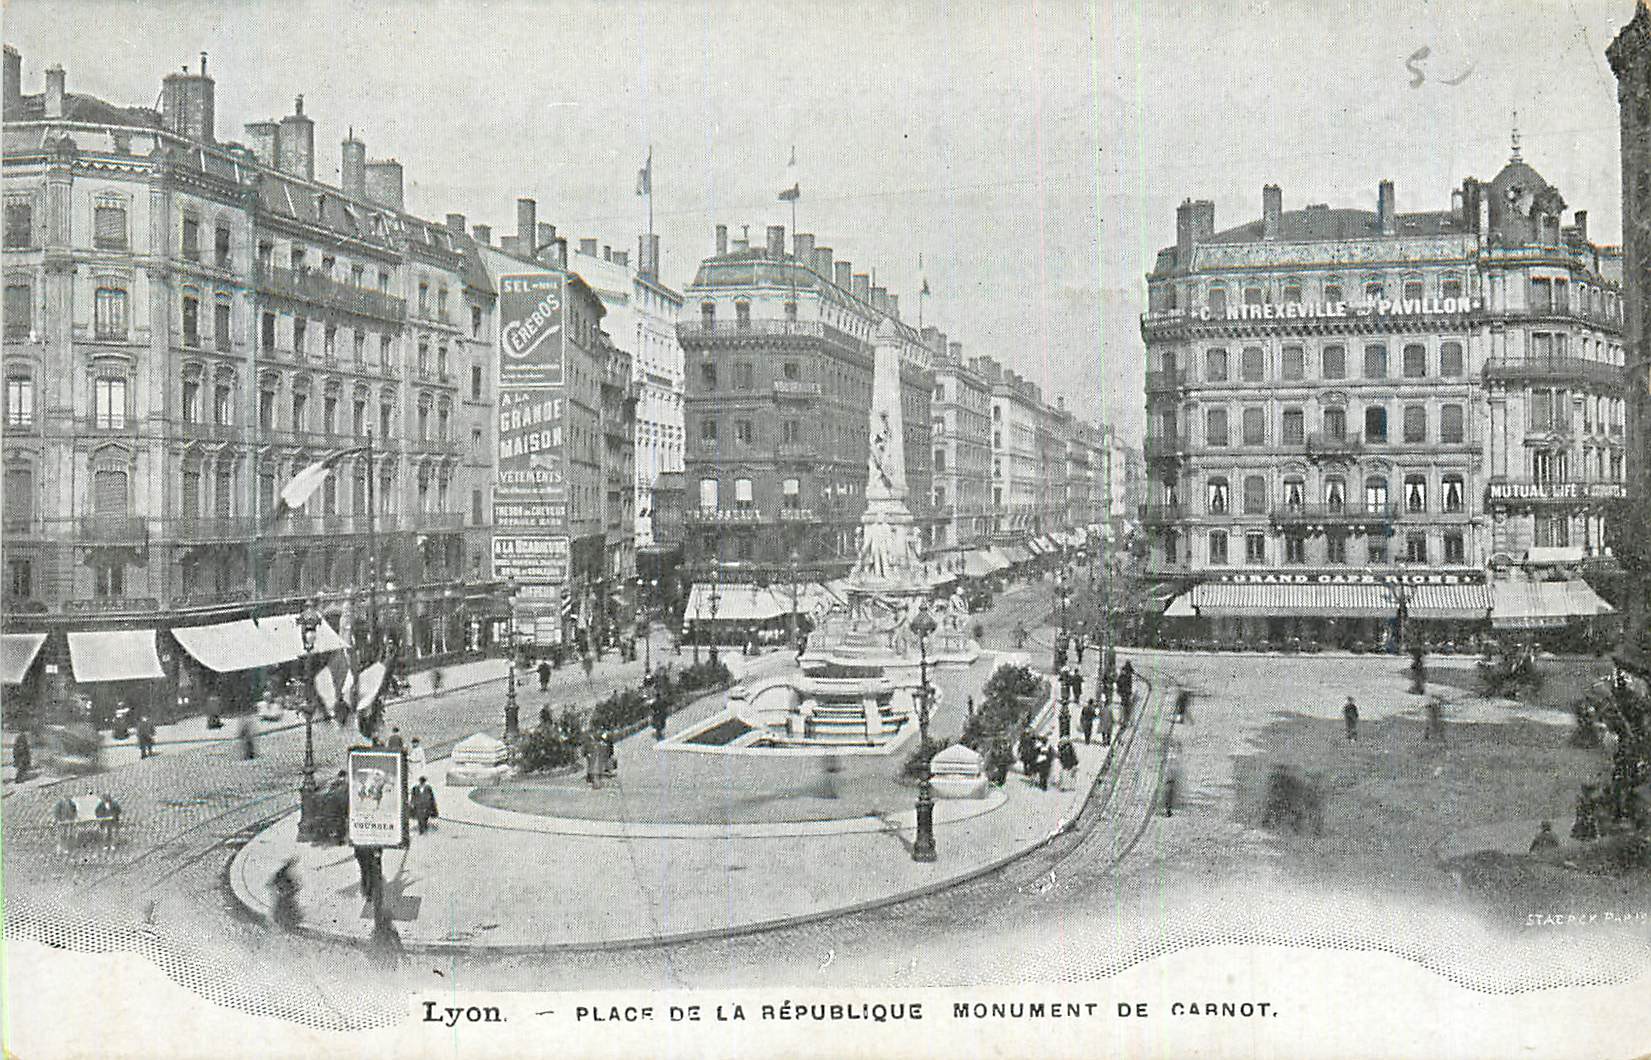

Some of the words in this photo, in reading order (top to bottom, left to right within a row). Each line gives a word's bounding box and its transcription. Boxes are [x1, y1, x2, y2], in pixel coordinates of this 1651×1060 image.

[1378, 297, 1470, 315] PAVILLON
[500, 398, 562, 432] GRANDE
[500, 426, 562, 458] MAISON
[1491, 484, 1547, 498] MUTUAL
[1233, 575, 1308, 583] GRAND
